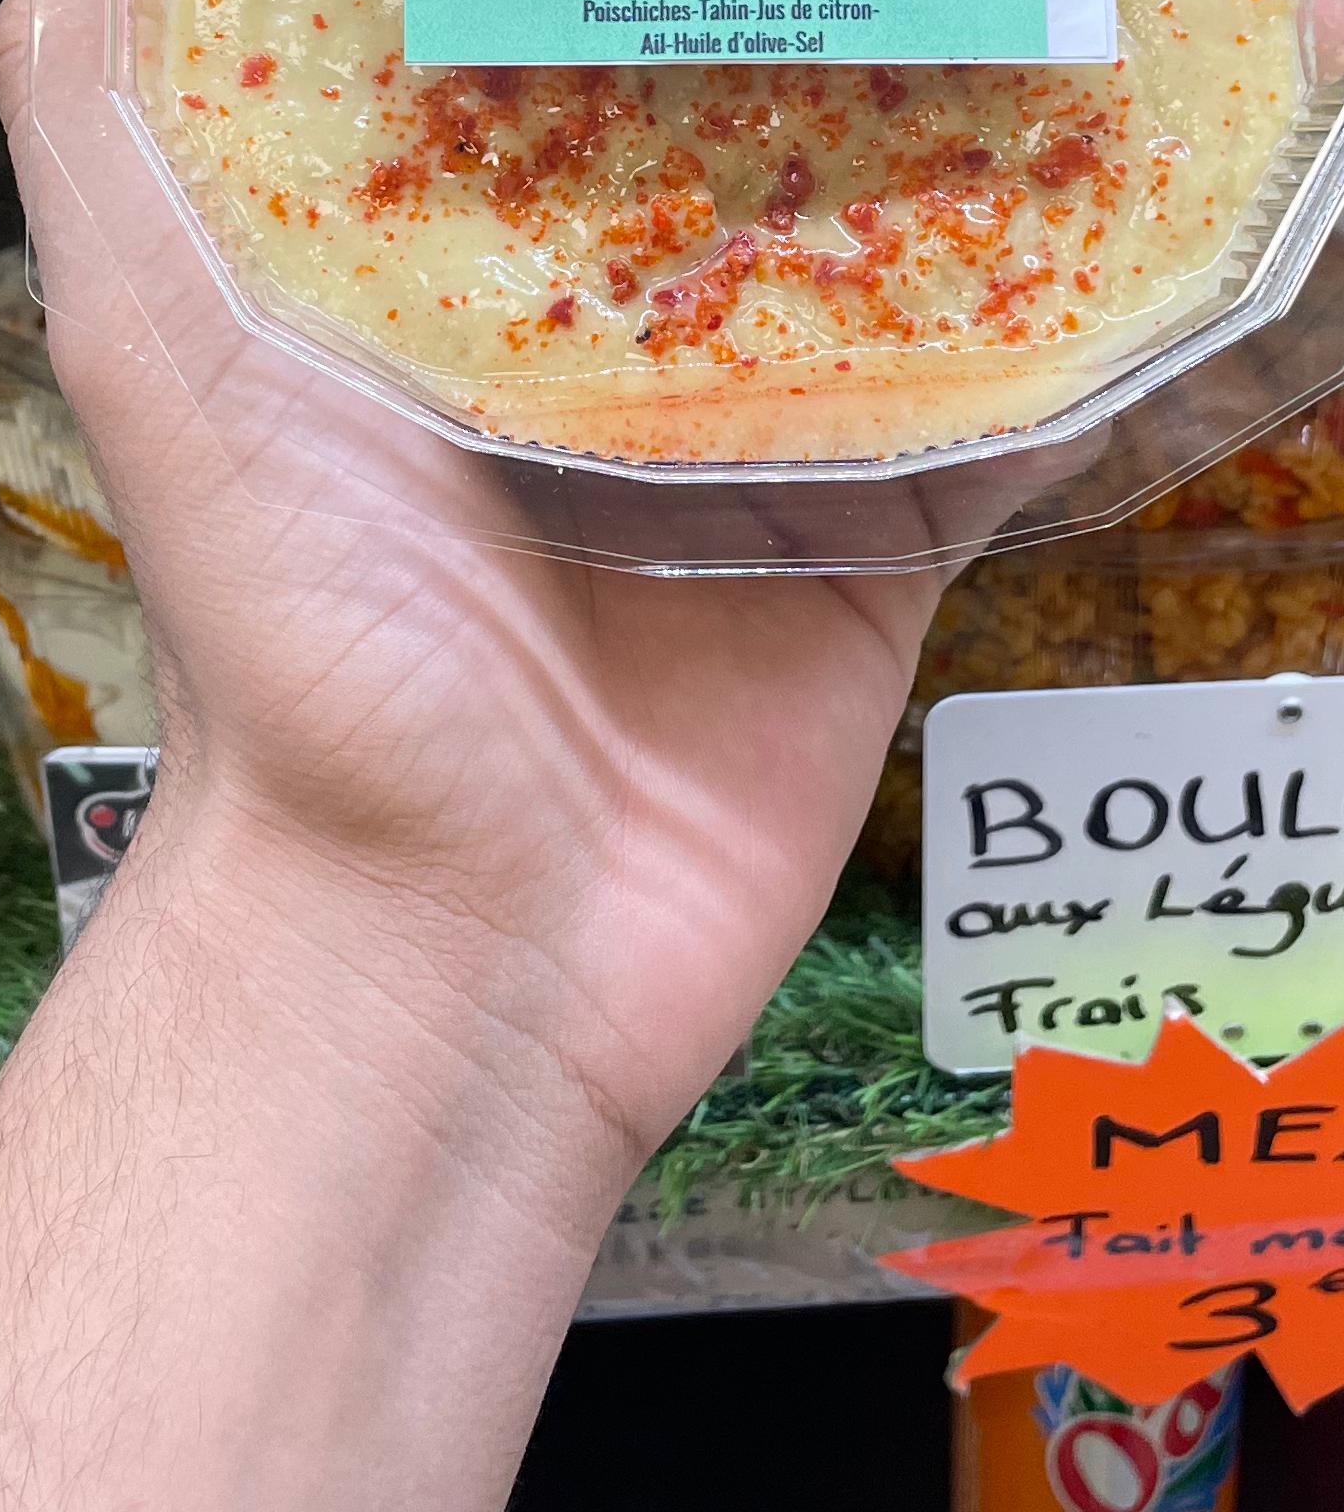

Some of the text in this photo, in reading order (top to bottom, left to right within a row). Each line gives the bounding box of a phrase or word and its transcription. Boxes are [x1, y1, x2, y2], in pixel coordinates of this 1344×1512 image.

[791, 0, 812, 22] de
[640, 32, 824, 56] Ail-Huile d'olive-Sel
[946, 897, 1113, 940] aux
